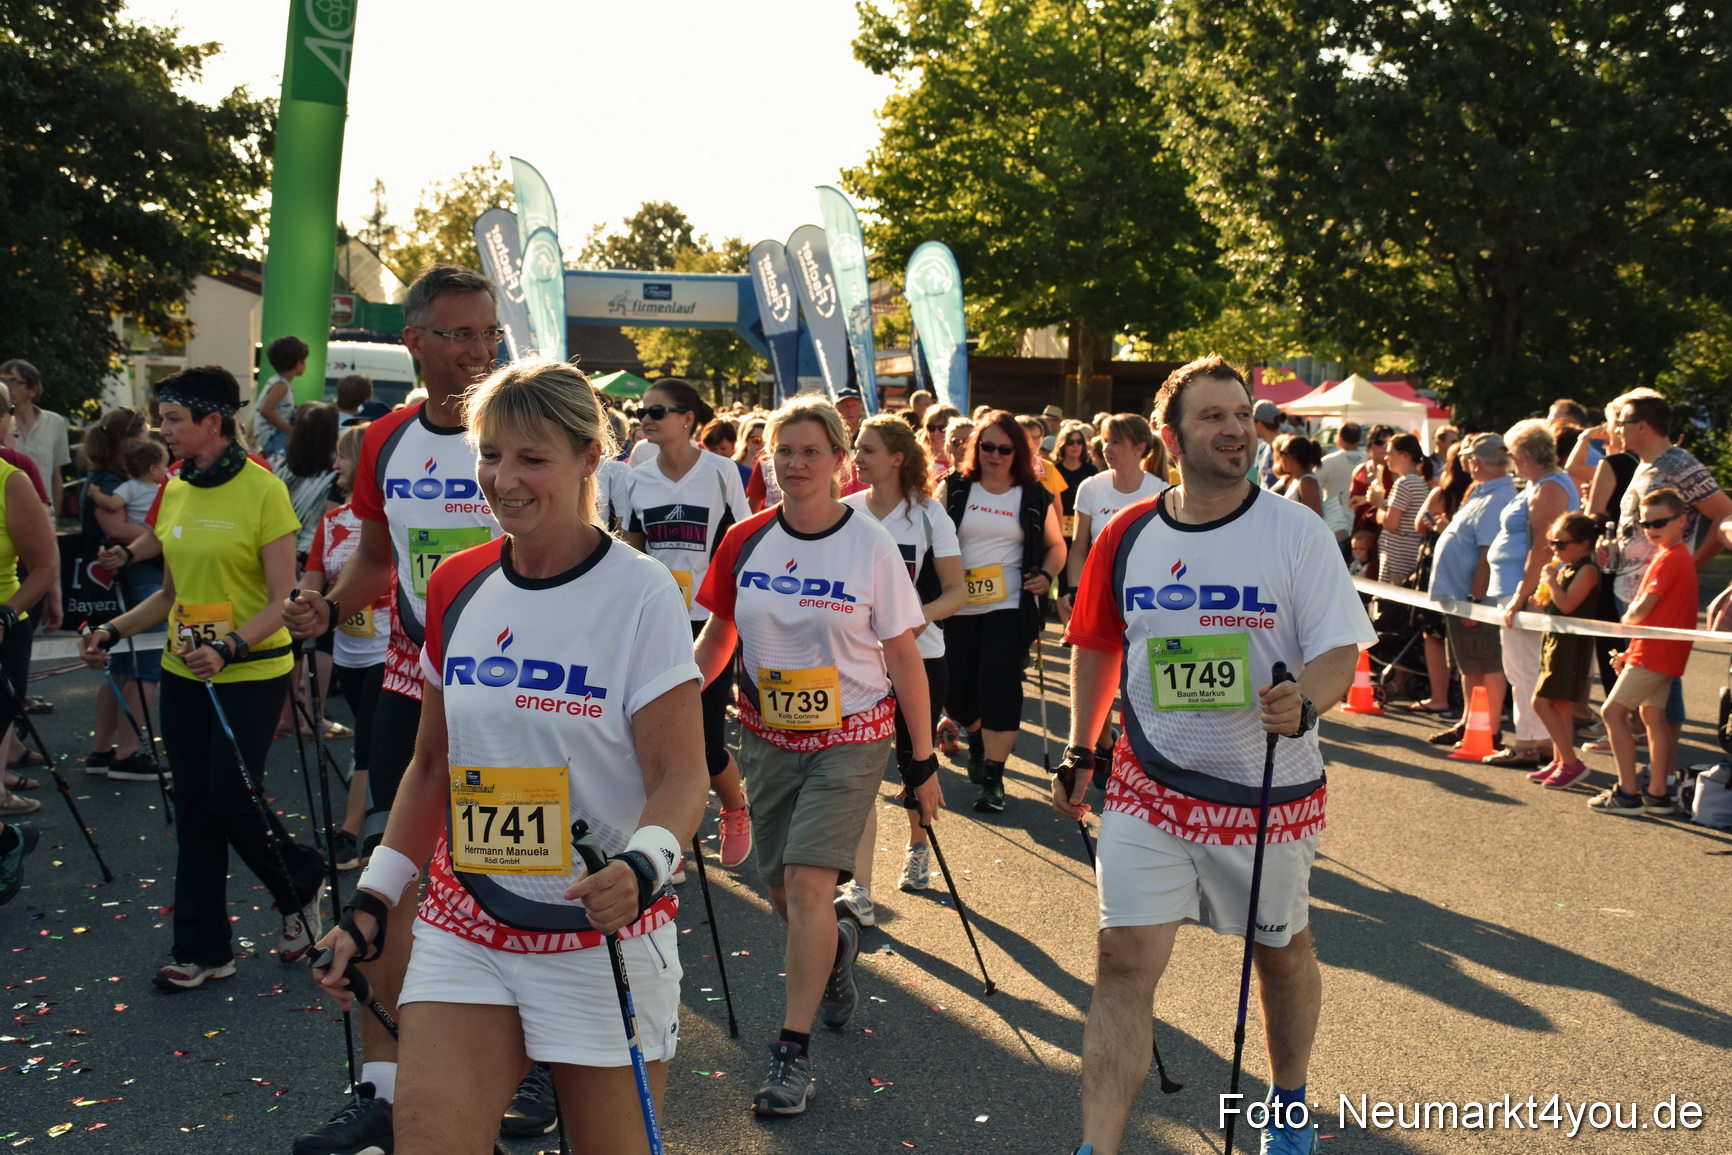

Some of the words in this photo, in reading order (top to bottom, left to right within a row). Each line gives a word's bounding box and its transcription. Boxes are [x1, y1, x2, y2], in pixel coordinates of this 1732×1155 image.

[632, 299, 697, 315] firmenlauf
[444, 503, 493, 515] energ
[416, 554, 441, 579] 17
[967, 579, 994, 595] 879
[799, 598, 854, 614] energie
[1199, 608, 1275, 629] energie
[1163, 661, 1236, 690] 1749
[515, 691, 603, 718] energie
[768, 690, 829, 713] 1739
[1177, 690, 1198, 698] Baum
[1186, 805, 1257, 829] AVIA
[1266, 796, 1321, 828] AVIA
[462, 806, 545, 844] 1741
[464, 844, 504, 857] Herrmann
[506, 846, 549, 857] Manuela
[499, 857, 521, 865] GmbH
[502, 932, 584, 953] AVIA
